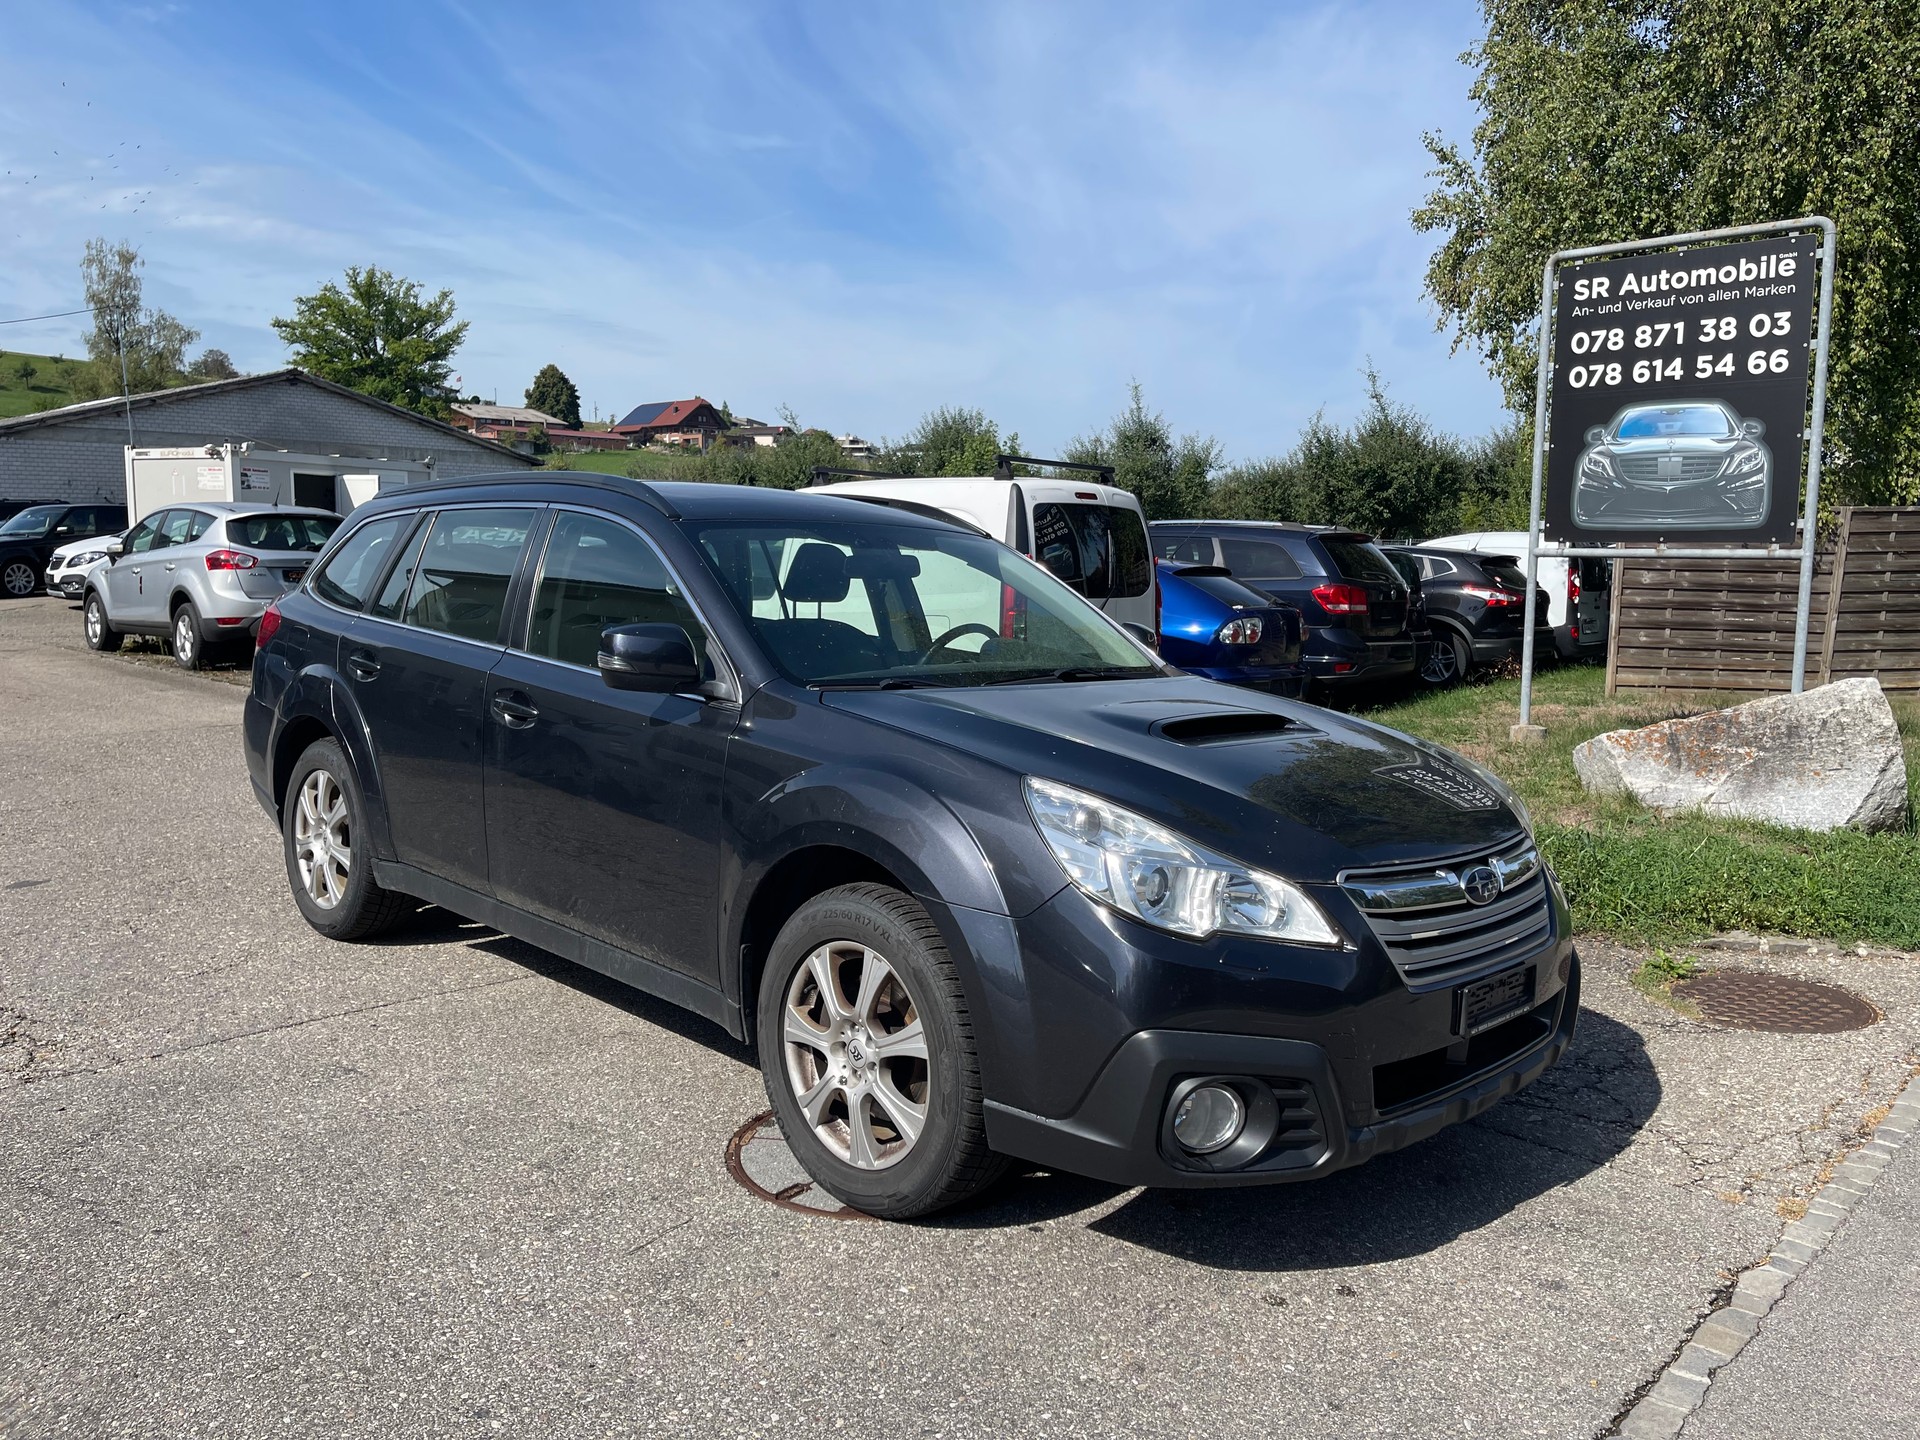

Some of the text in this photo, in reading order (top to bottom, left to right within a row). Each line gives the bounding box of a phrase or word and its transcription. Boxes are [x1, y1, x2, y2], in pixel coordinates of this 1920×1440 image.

[1778, 251, 1798, 259] GmbH
[1573, 254, 1797, 301] SR Automobile
[1571, 282, 1796, 318] An- und Verkauf von allen Marken
[1570, 310, 1792, 355] 078 871 38 03
[1568, 348, 1790, 389] 078 614 54 66
[823, 909, 852, 920] 225/60
[854, 914, 872, 927] R17
